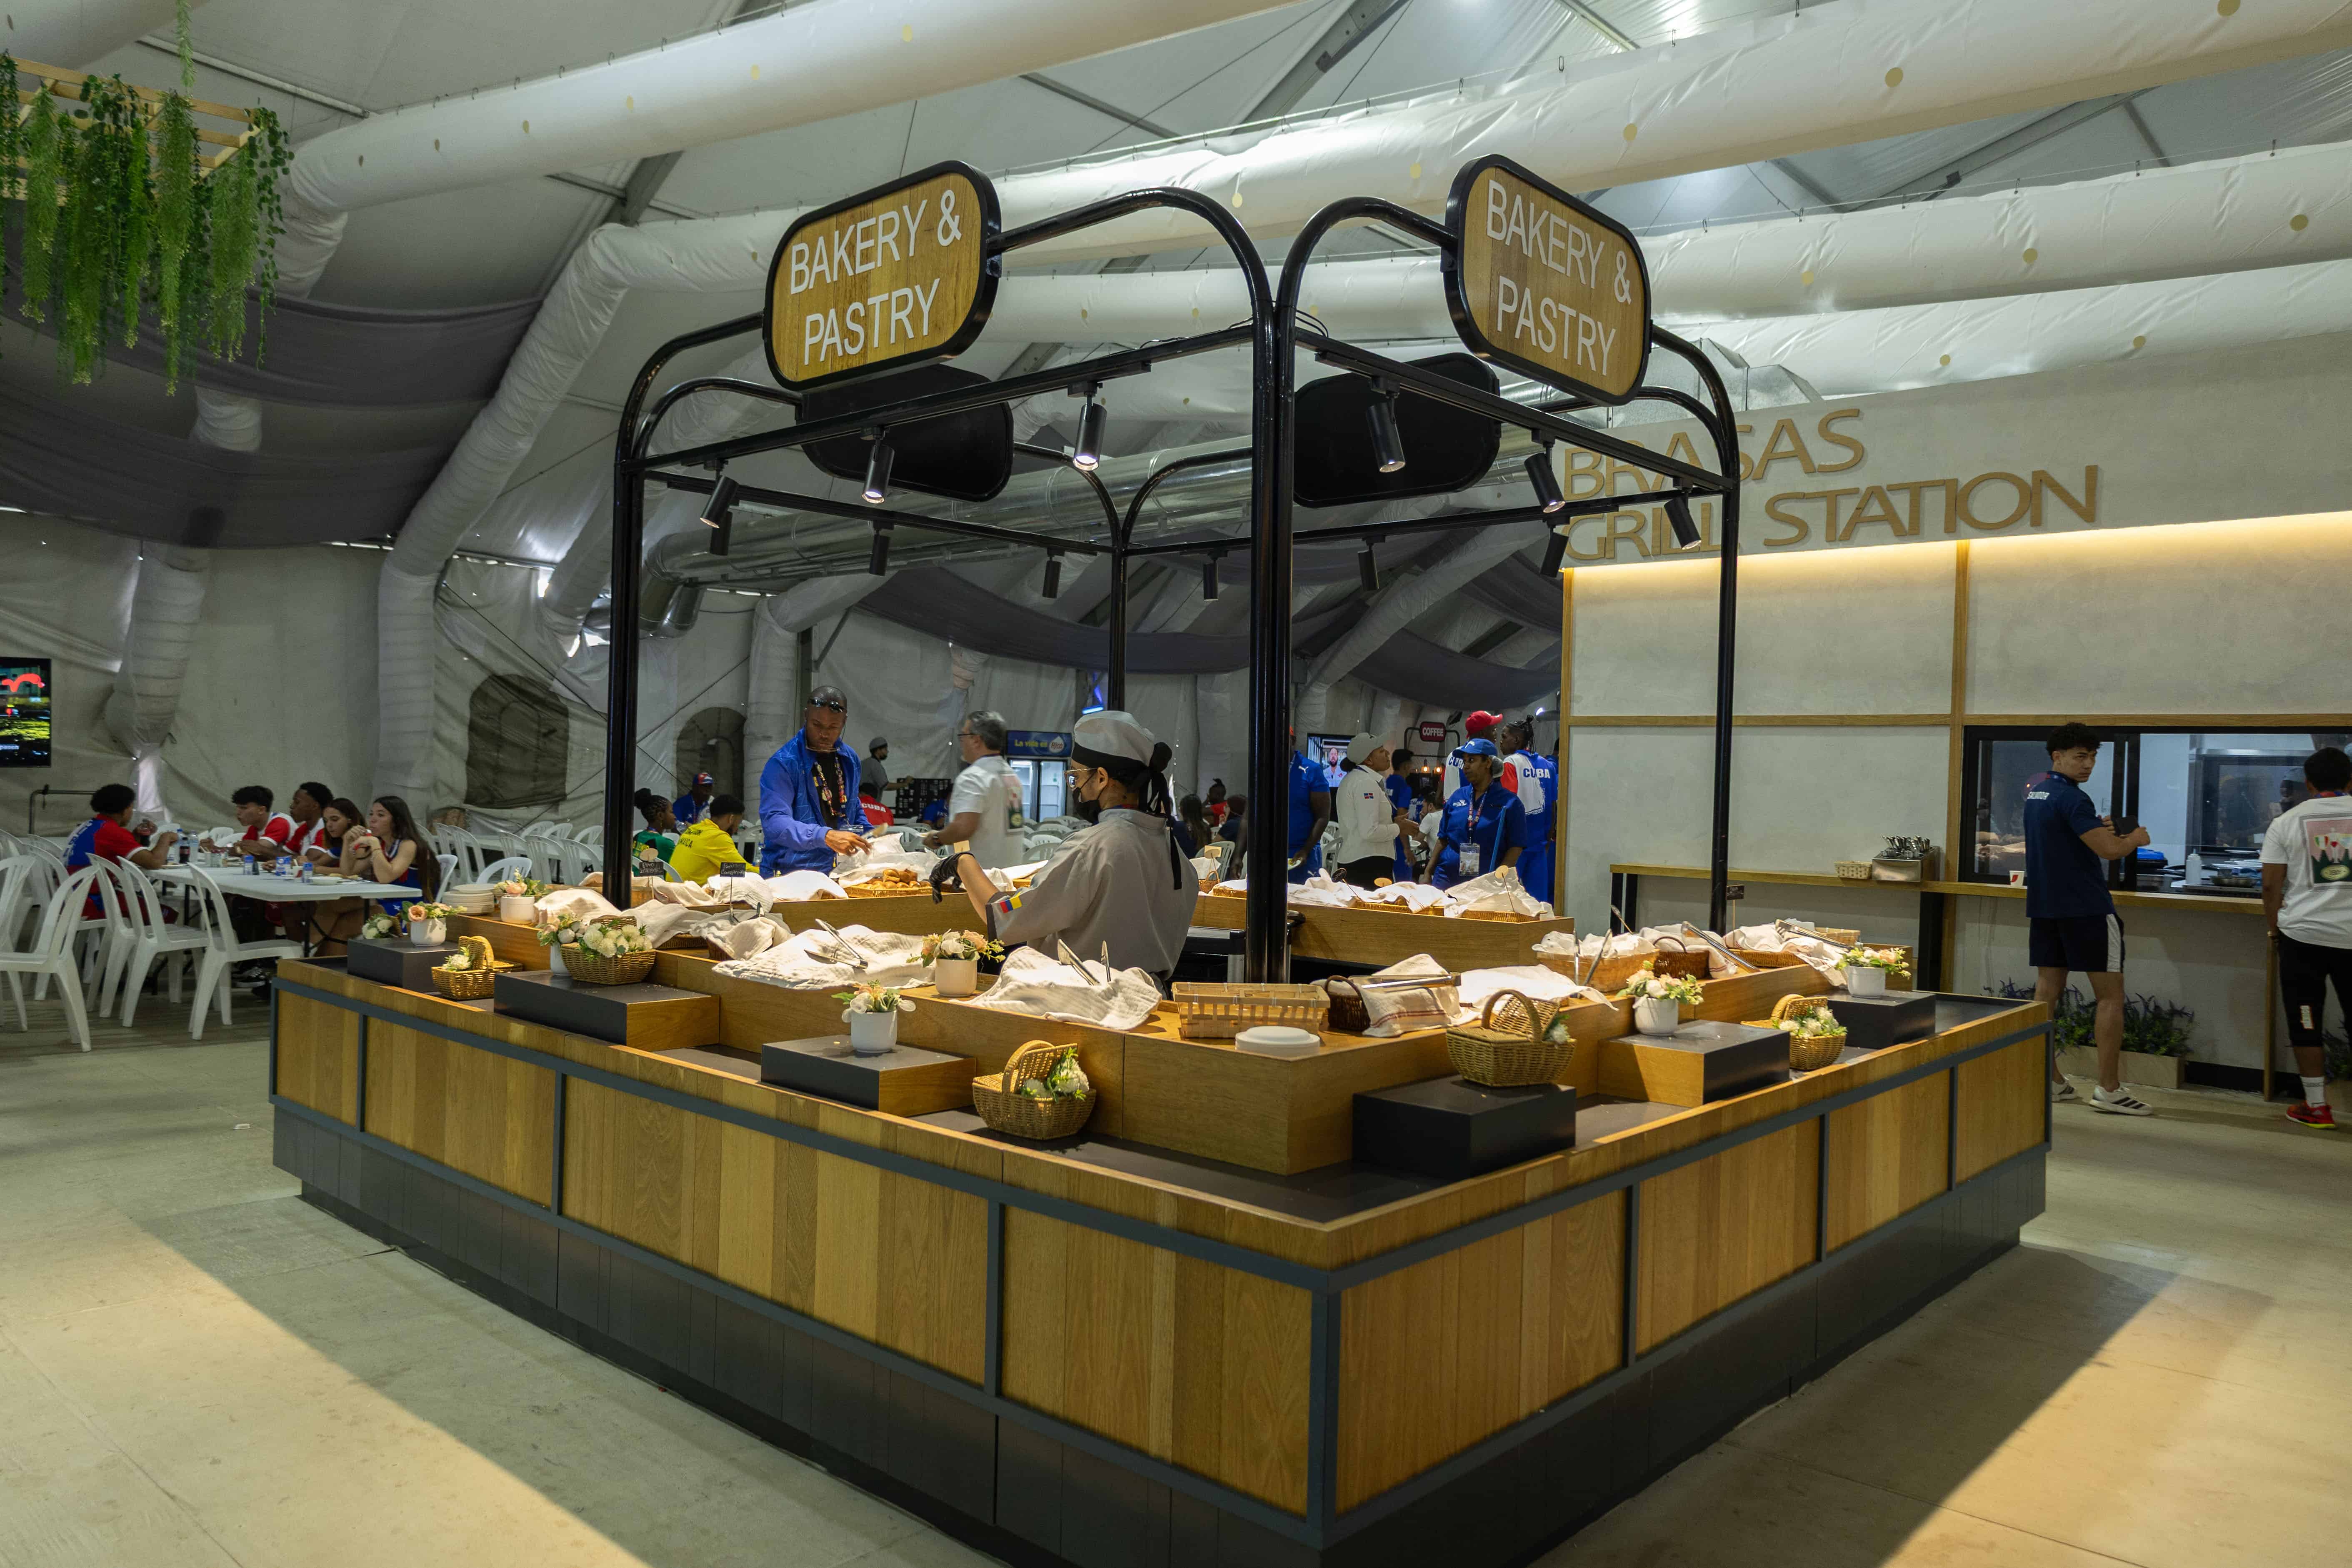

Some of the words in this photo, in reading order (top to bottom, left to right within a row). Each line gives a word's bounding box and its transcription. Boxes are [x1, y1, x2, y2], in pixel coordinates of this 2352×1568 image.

[791, 200, 927, 295] BAKERY
[937, 190, 962, 247] &
[1486, 180, 1605, 290] BAKERY
[1614, 250, 1631, 305] &
[804, 278, 940, 365] PASTRY
[1497, 275, 1616, 376] PASTRY
[1562, 501, 1741, 560] GRILL
[1763, 465, 2099, 546] STATION
[1422, 727, 1444, 737] COFFEE
[1523, 768, 1551, 779] CUBA
[861, 803, 886, 813] CUBA
